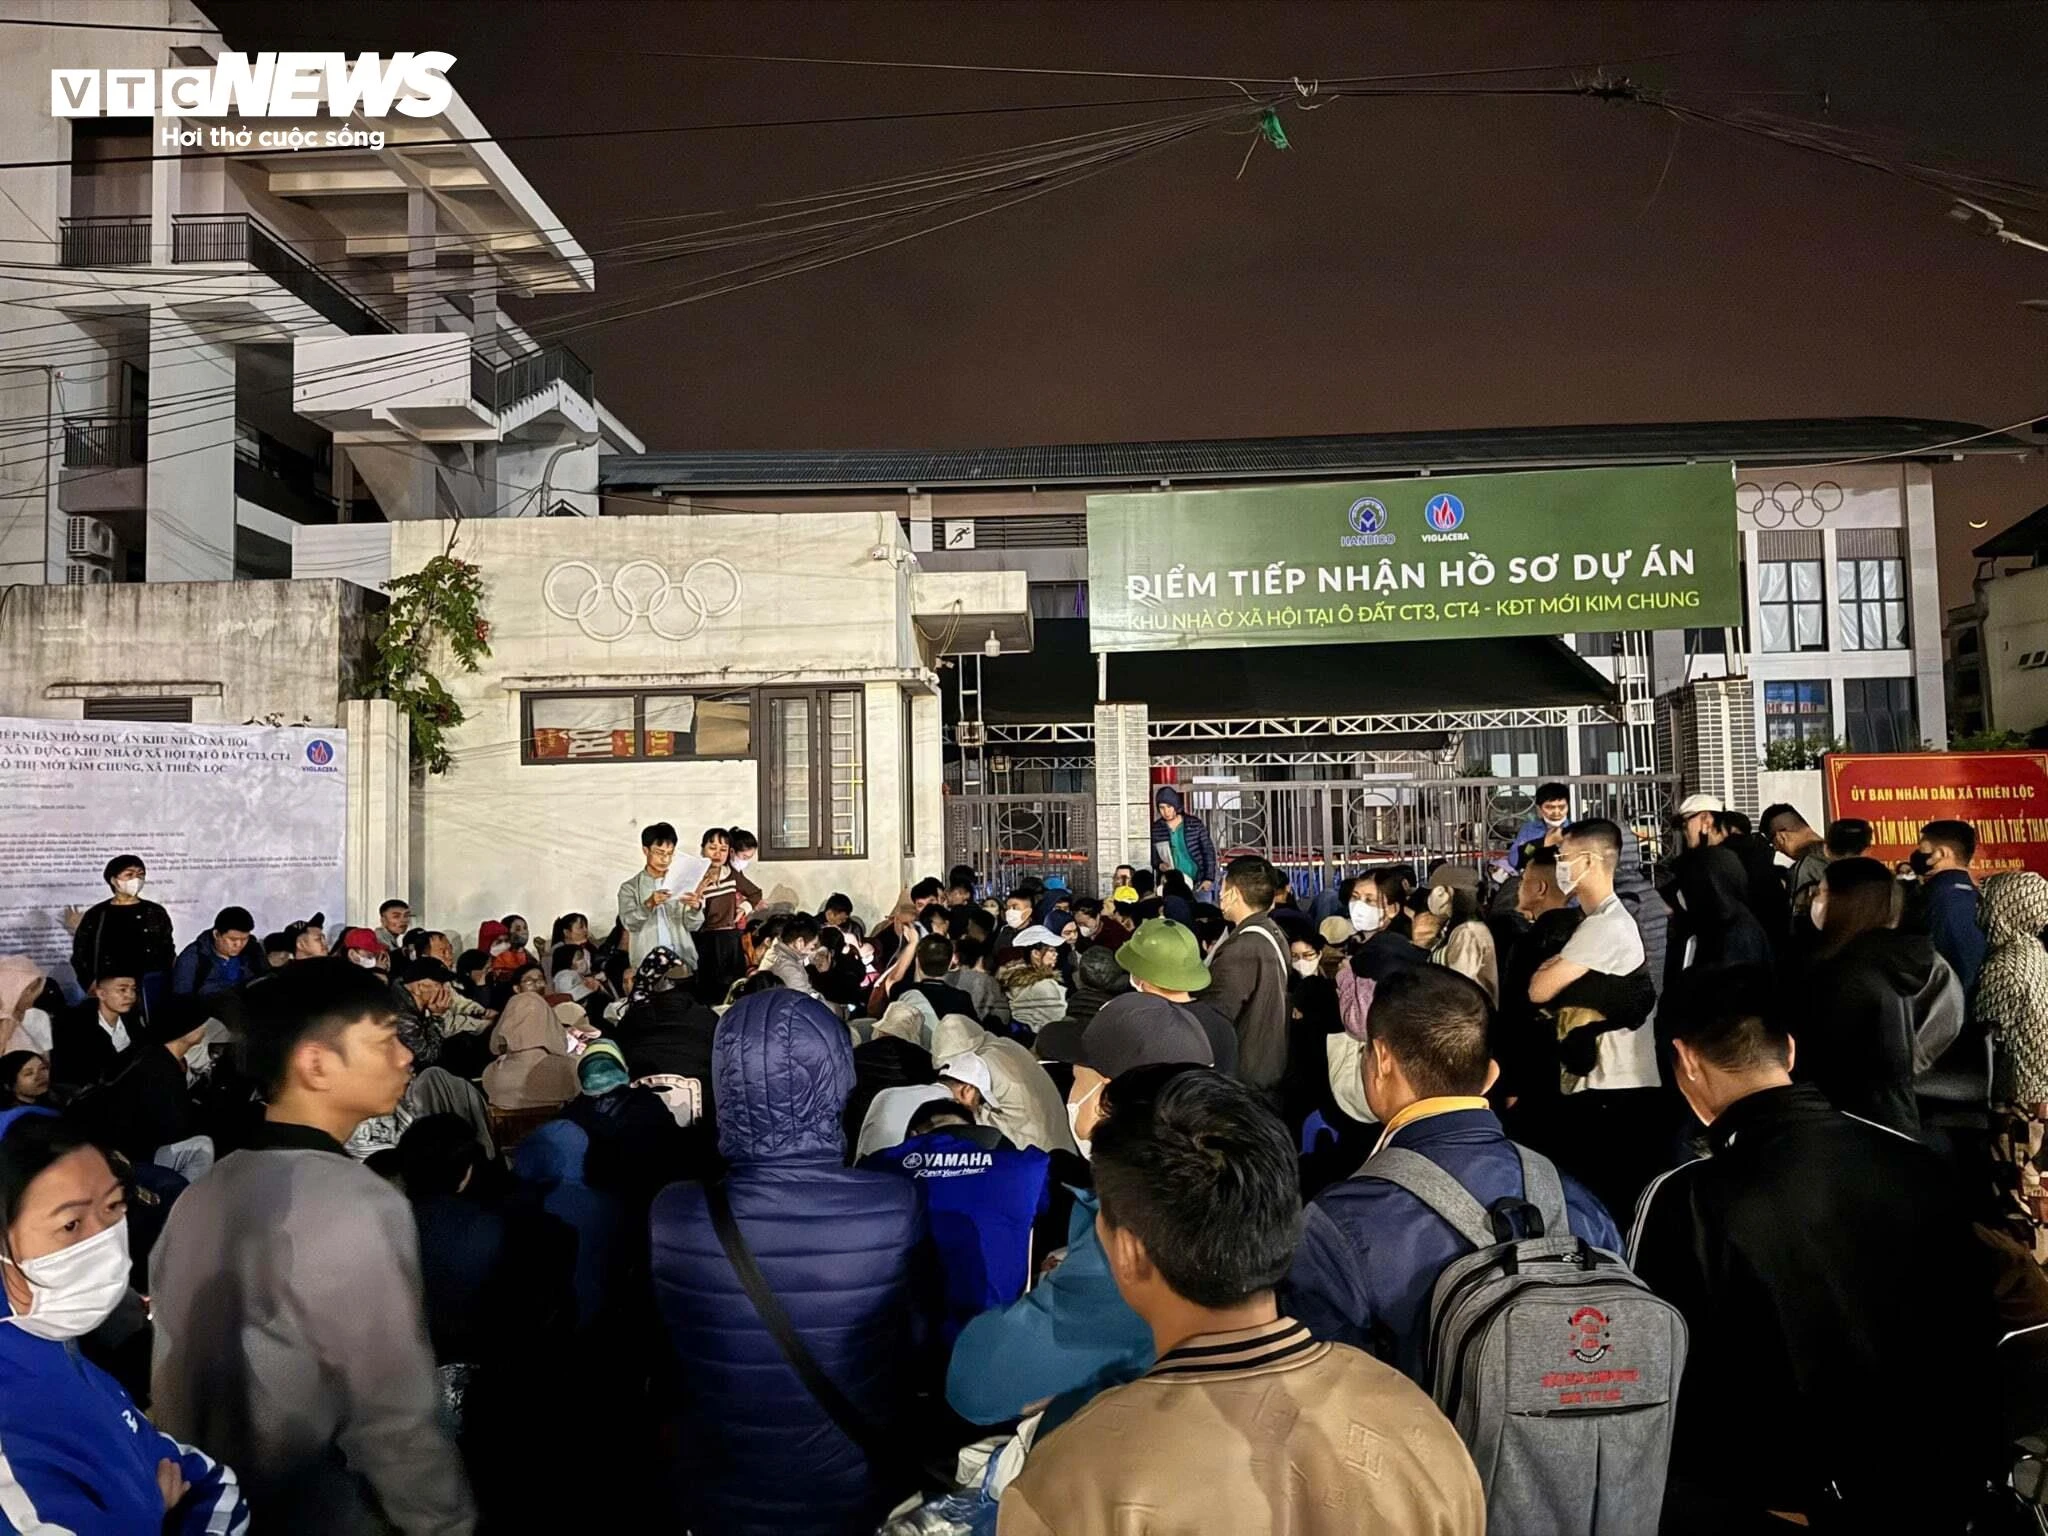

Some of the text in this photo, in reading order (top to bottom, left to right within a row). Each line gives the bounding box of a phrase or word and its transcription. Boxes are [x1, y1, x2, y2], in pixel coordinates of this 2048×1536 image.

[1421, 532, 1469, 543] VIGLACERA
[1126, 544, 1695, 600] ĐIỂM TIẾP NHẬN HỒ SƠ DỰ ÁN
[1128, 611, 1168, 630] KHU
[1173, 606, 1214, 630] NHÀ
[1217, 608, 1235, 628] Ở
[1238, 608, 1264, 627] XÃ
[1268, 606, 1302, 629] HỘI
[1305, 608, 1333, 627] TẠI
[1338, 604, 1354, 623] Ô
[1359, 601, 1396, 623] ĐẤT
[1400, 603, 1440, 621] CT3,
[1444, 601, 1480, 618] CT4
[1496, 598, 1535, 617] KĐT
[1540, 593, 1580, 614] MỚI
[1585, 595, 1622, 612] KIM
[1627, 591, 1700, 610] CHUNG
[1869, 788, 1893, 801] BAN
[1976, 819, 1994, 844] TIN
[924, 1152, 993, 1167] YAMAHA
